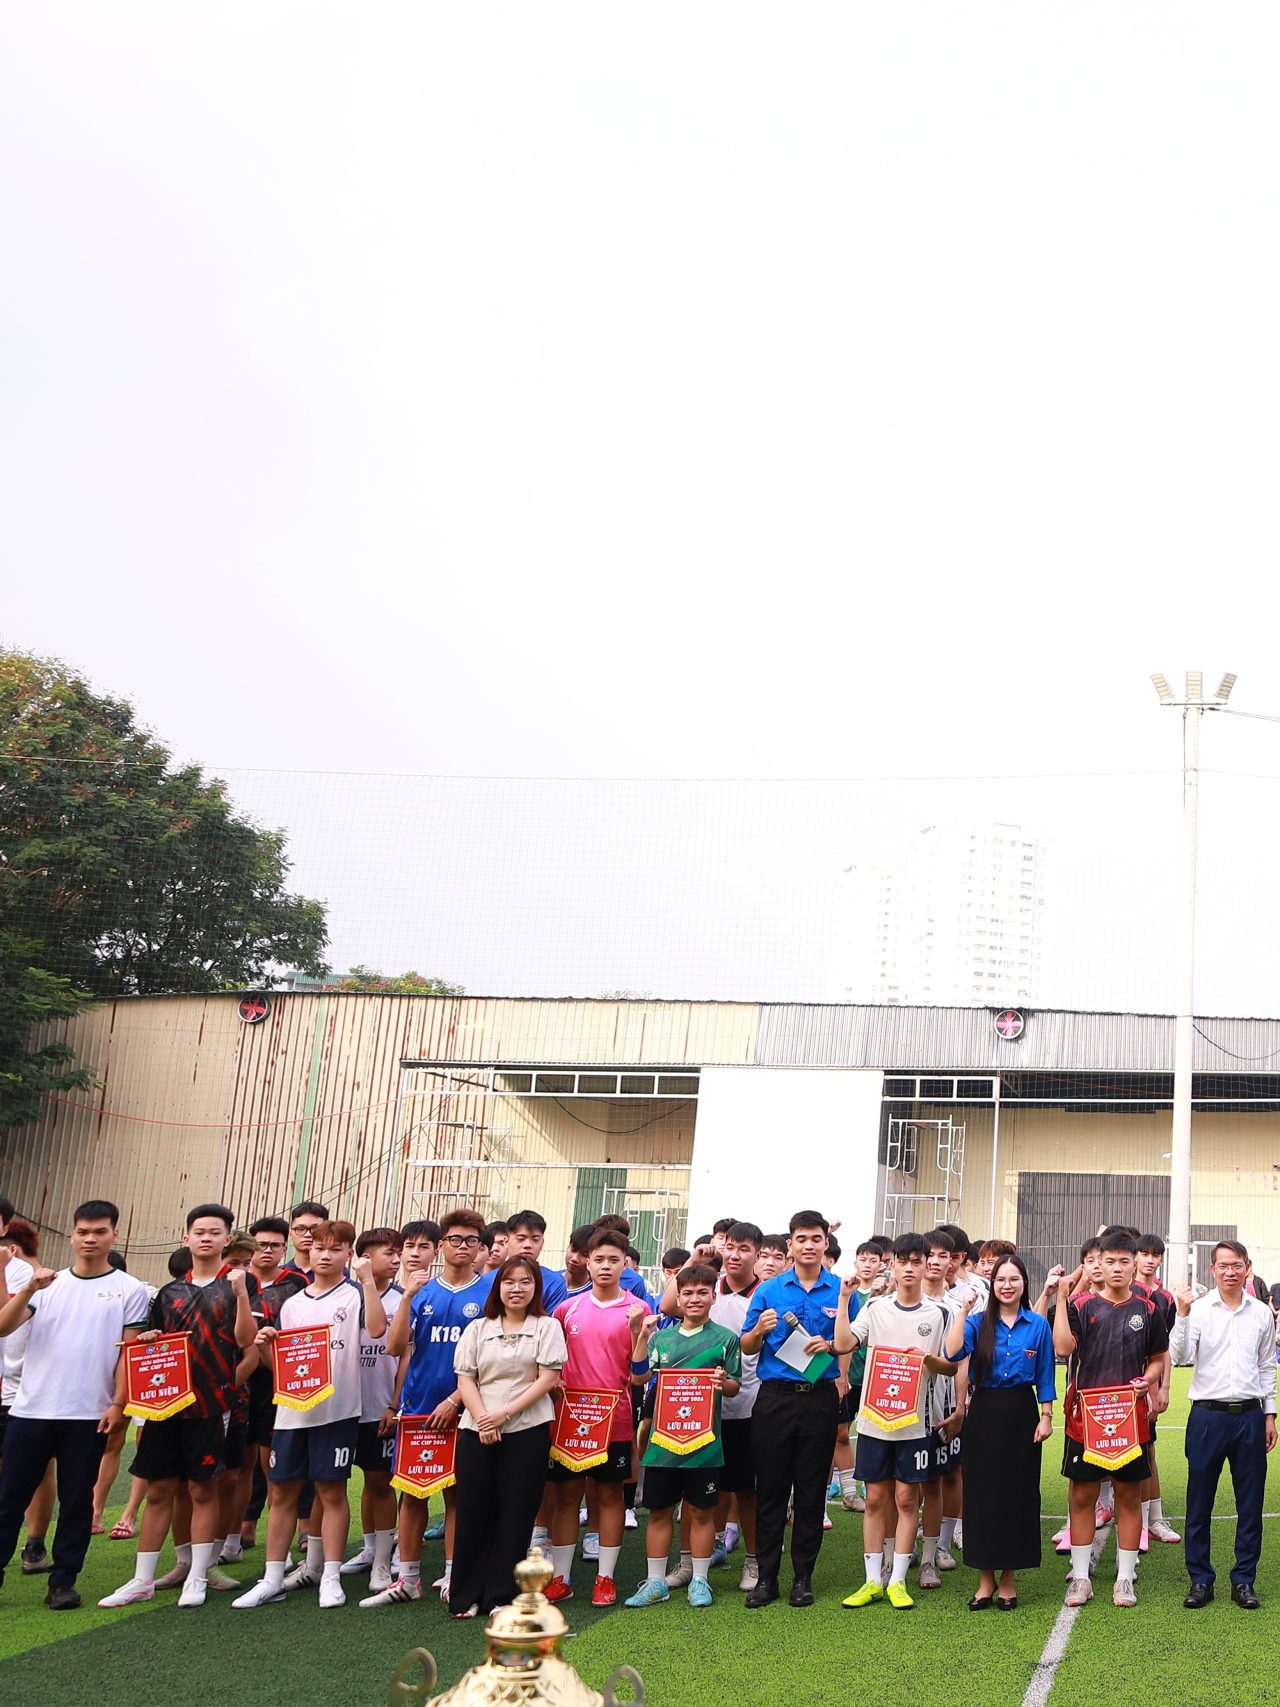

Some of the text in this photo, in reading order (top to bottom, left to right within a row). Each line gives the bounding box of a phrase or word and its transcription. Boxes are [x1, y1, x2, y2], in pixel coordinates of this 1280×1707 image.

[430, 1326, 461, 1343] K18
[287, 1377, 320, 1390] LƯU NIỆM
[140, 1386, 179, 1400] LƯU NIỆM
[876, 1398, 907, 1410] LƯU NIỆM
[667, 1420, 701, 1431] LƯU NIỆM
[382, 1438, 395, 1458] 12
[564, 1438, 598, 1450] LƯU NIỆM
[950, 1437, 960, 1456] 19
[1096, 1437, 1128, 1448] LƯU NIỆM
[334, 1447, 350, 1468] 10
[914, 1450, 928, 1470] 10
[936, 1446, 948, 1465] 15
[408, 1464, 444, 1474] LƯU NIỆM
